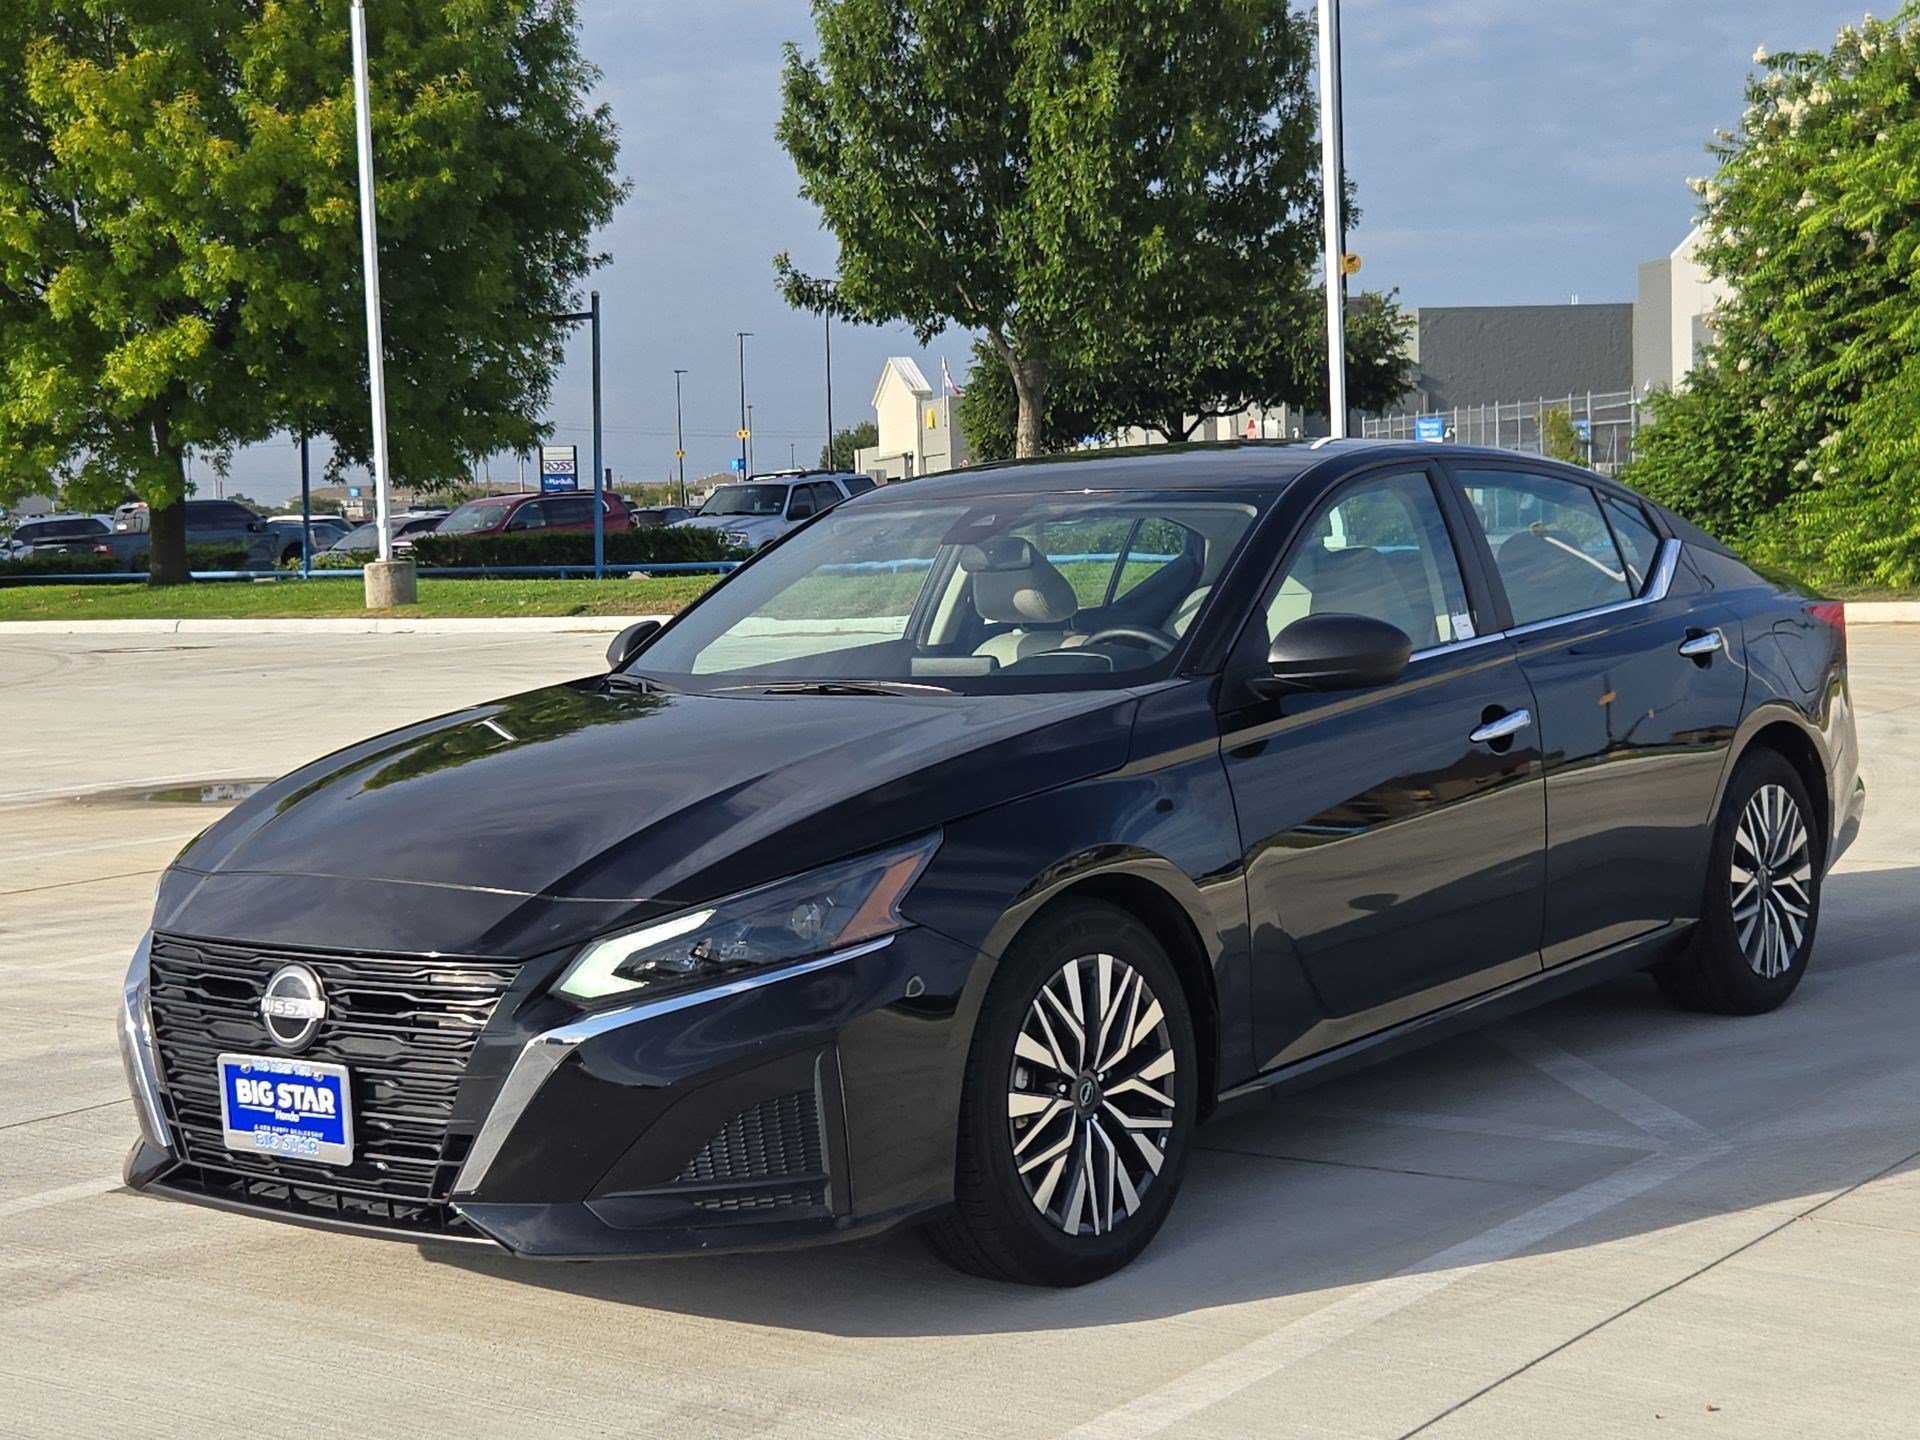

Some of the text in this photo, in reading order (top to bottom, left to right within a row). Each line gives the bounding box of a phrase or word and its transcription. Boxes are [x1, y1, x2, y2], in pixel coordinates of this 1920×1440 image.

[545, 462, 573, 471] ROSS
[261, 1000, 325, 1018] NISSAN
[236, 1078, 335, 1114] BIG STAR
